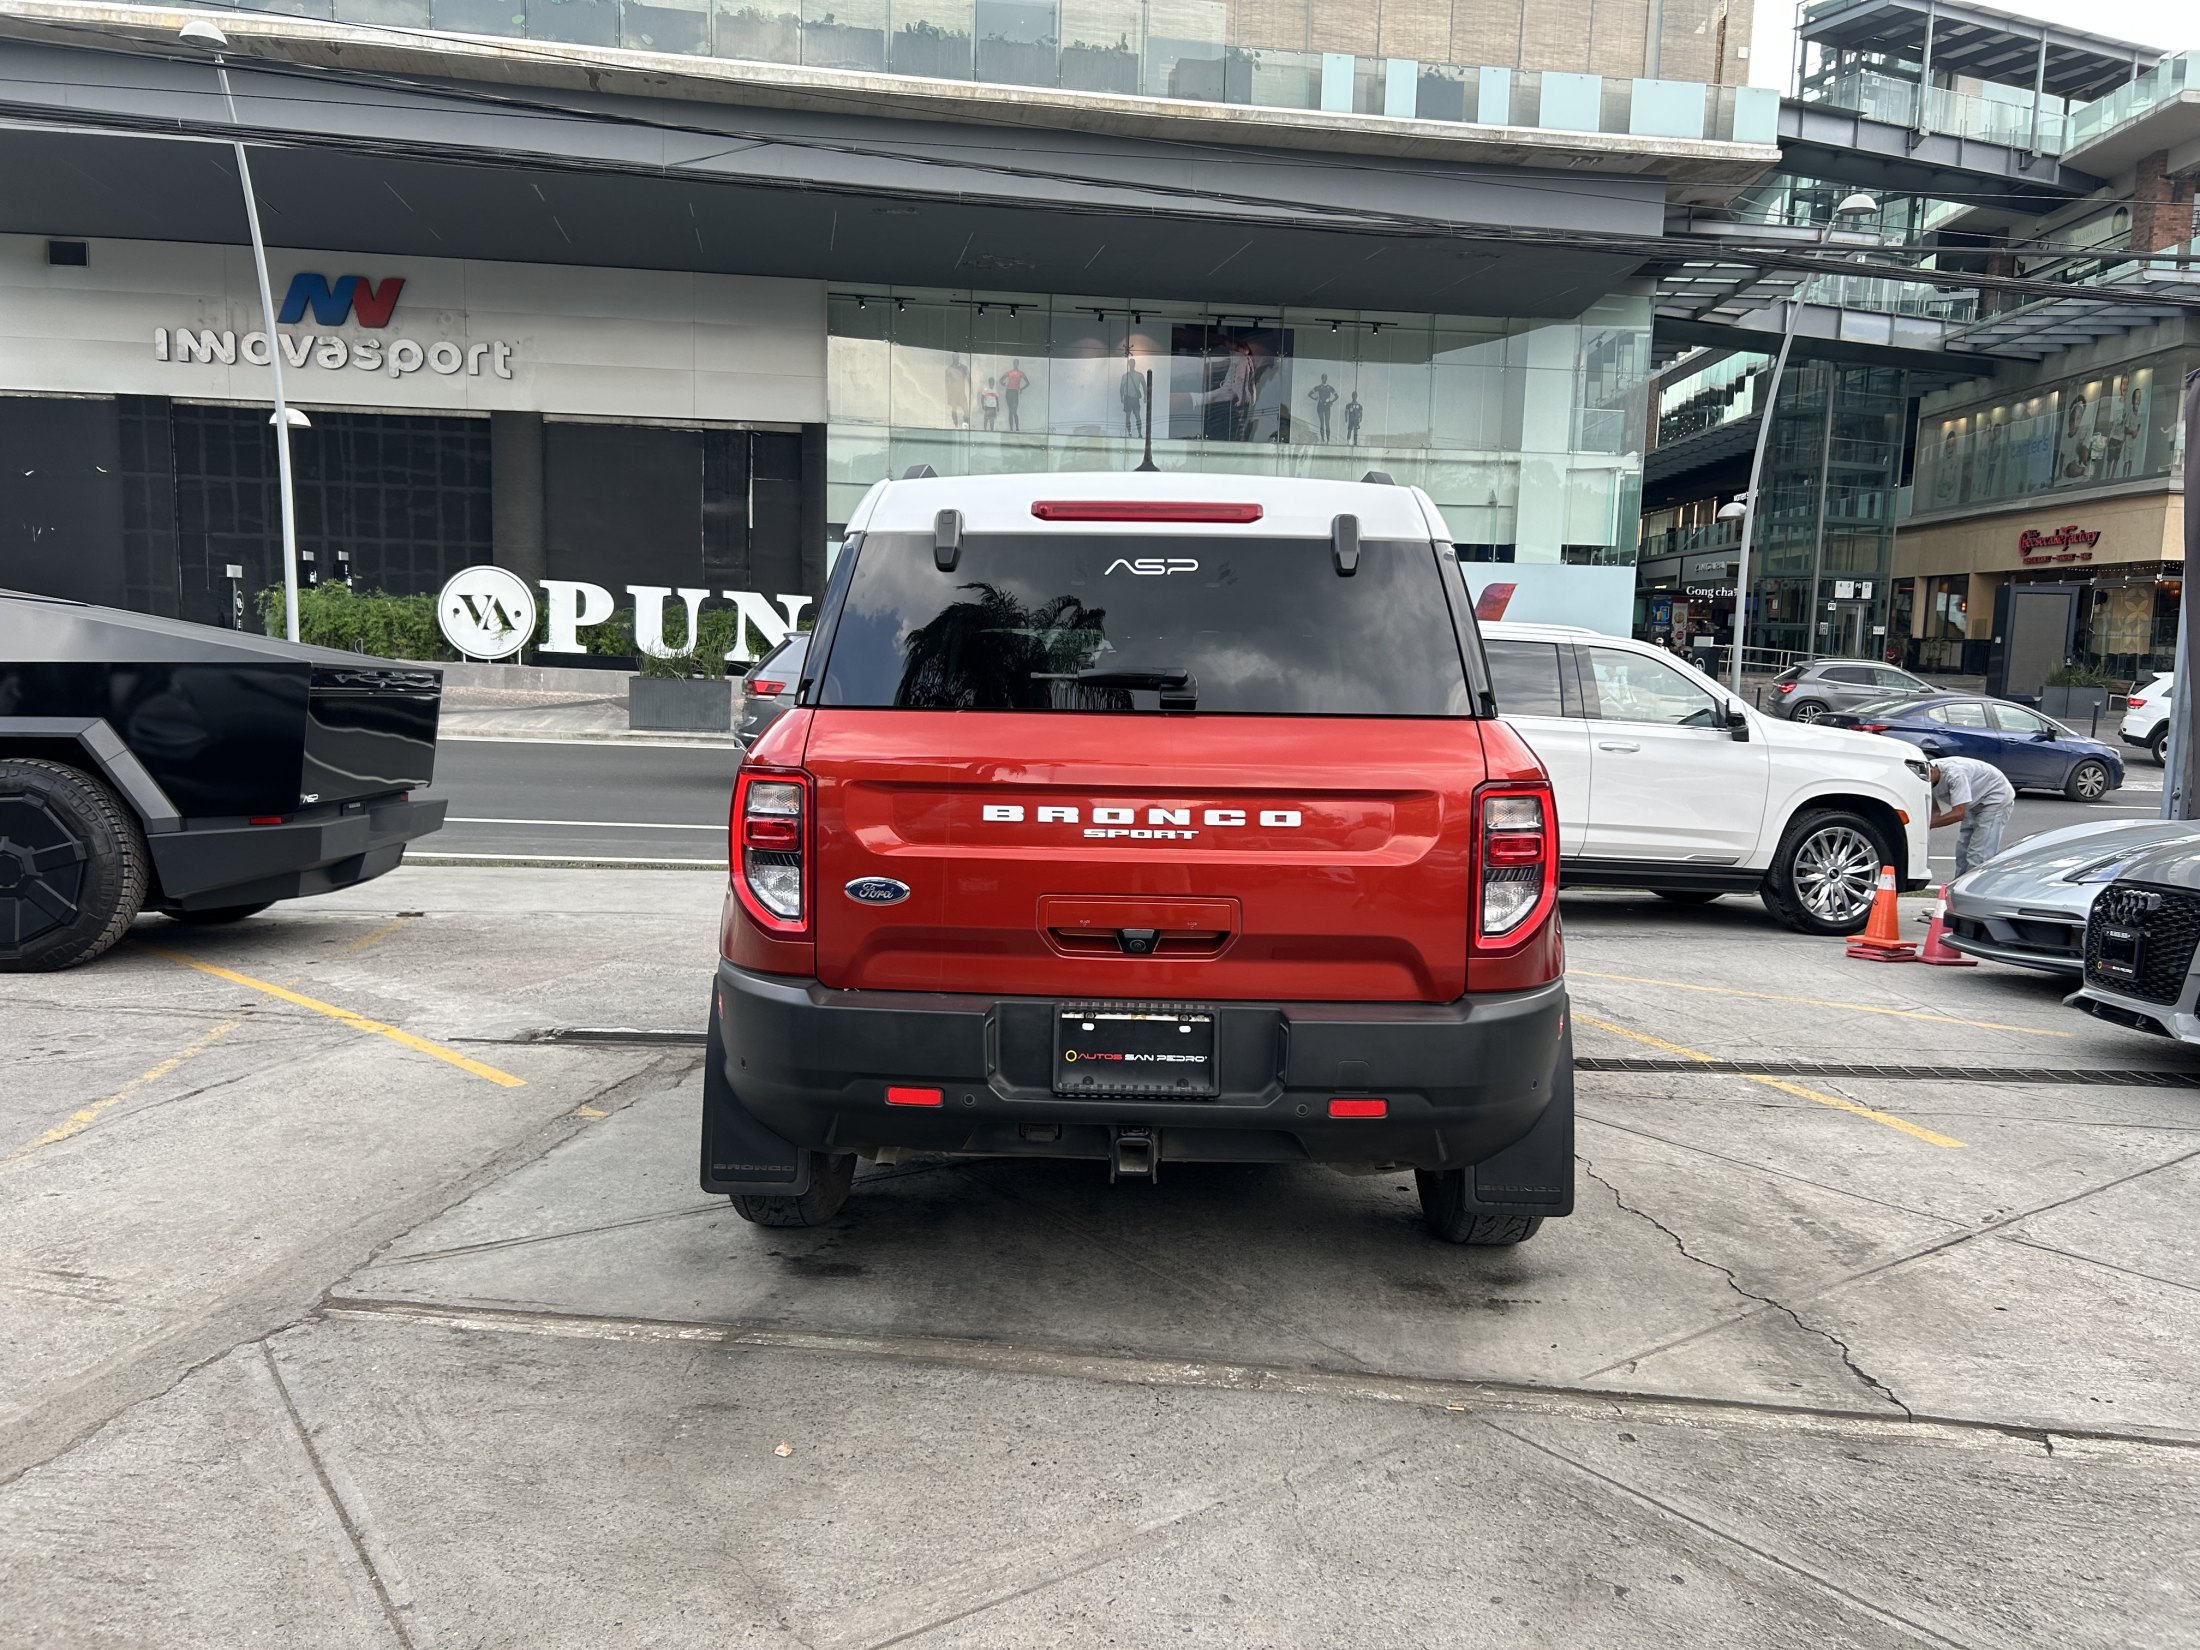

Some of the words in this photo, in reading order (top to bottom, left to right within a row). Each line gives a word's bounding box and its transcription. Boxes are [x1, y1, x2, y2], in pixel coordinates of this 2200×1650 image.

[1104, 559, 1199, 575] ASP
[1686, 585, 1715, 598] Gong
[1715, 586, 1733, 597] cha
[982, 804, 1302, 828] BRONCO
[1083, 828, 1199, 840] SPORT
[859, 882, 894, 899] Ford
[1125, 1053, 1154, 1061] SAN
[713, 1163, 794, 1172] BRONCO
[1477, 1184, 1561, 1193] BRONCO
